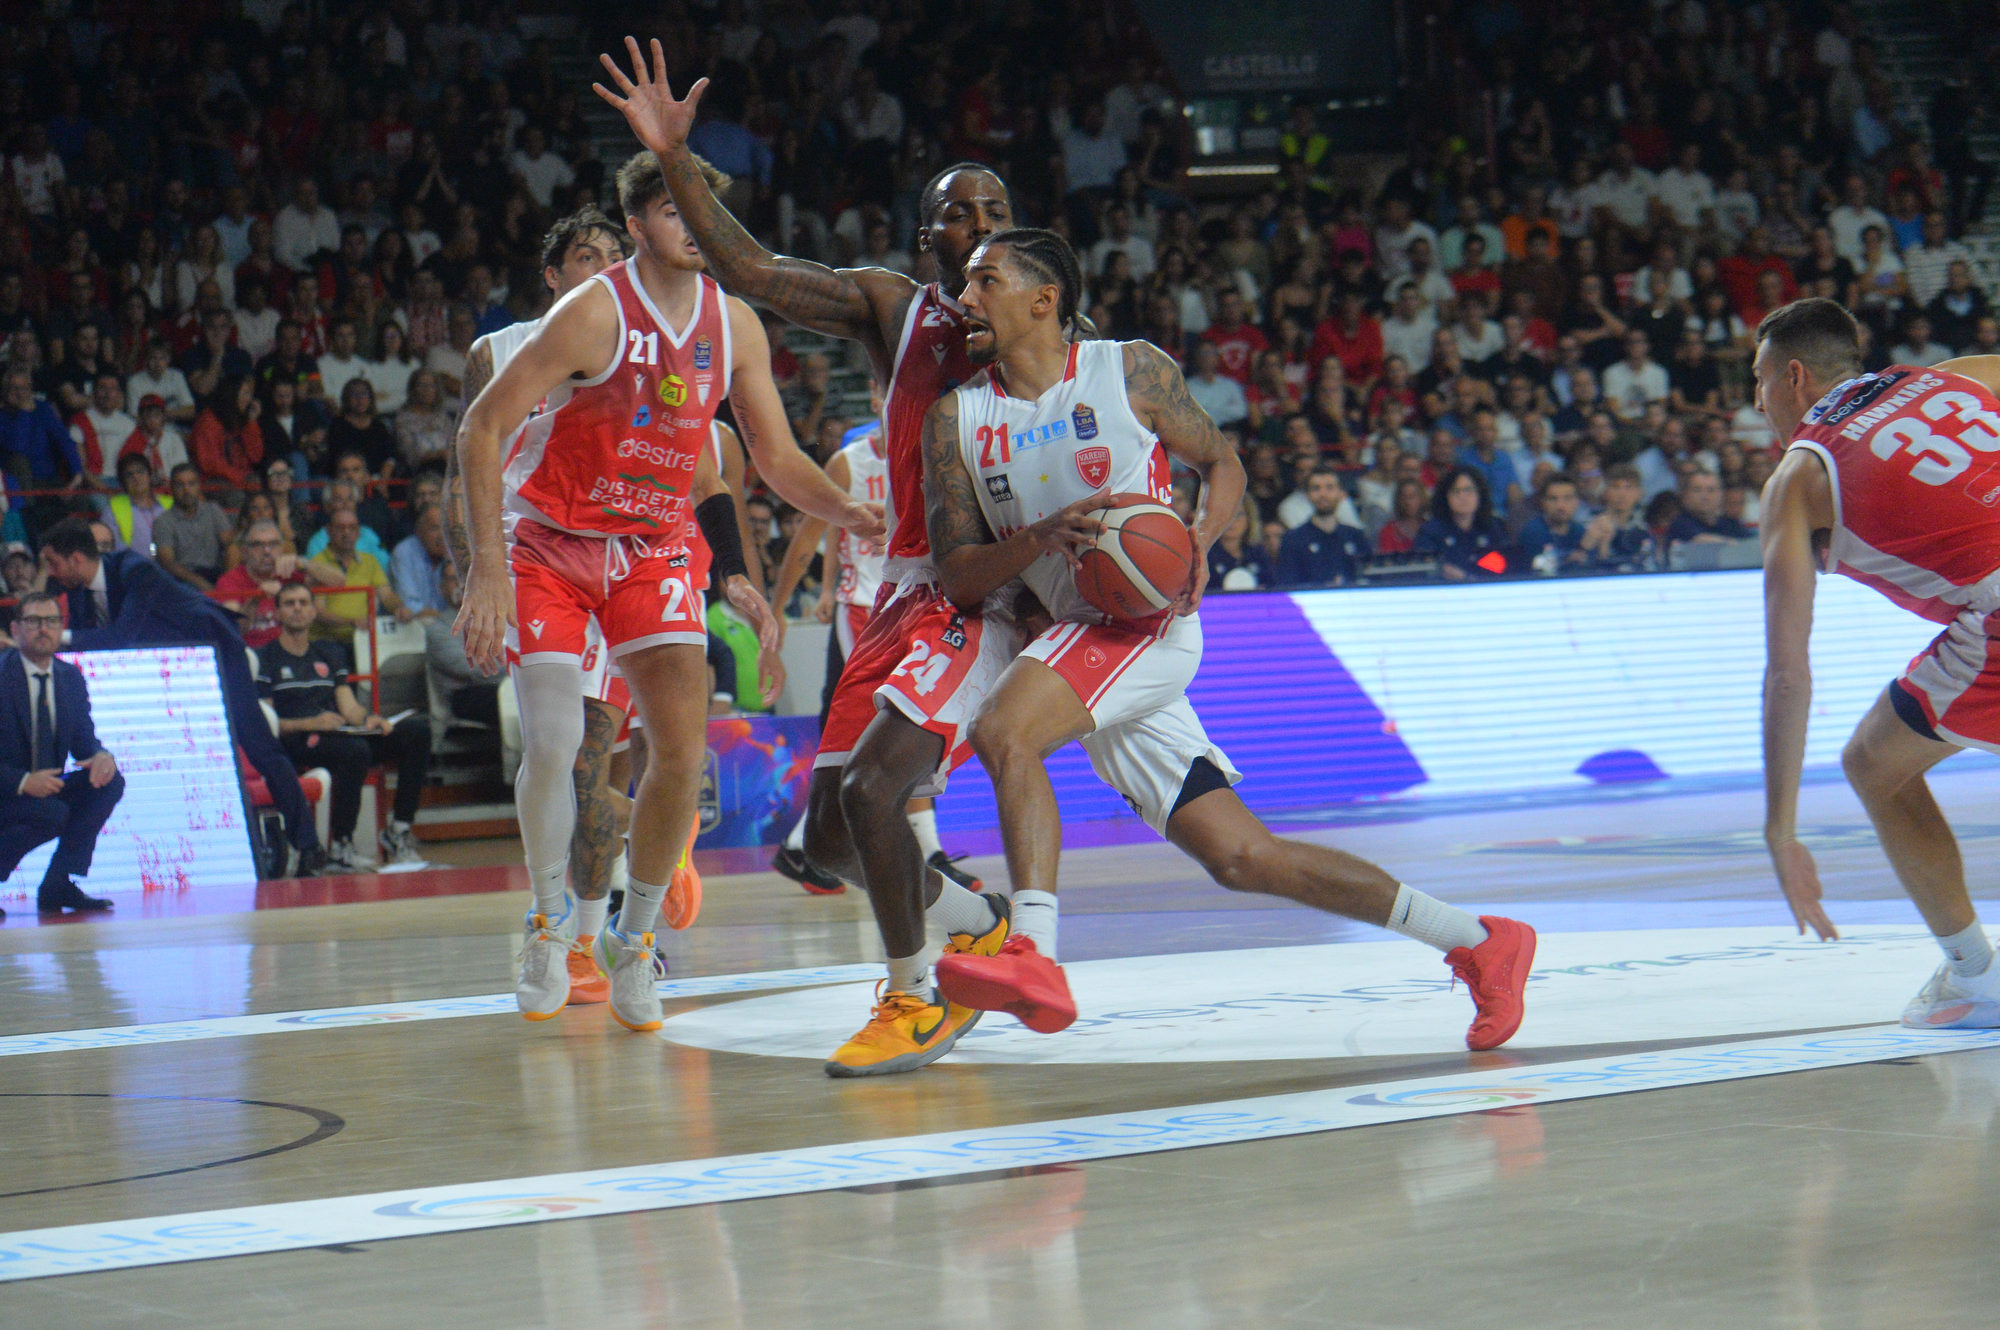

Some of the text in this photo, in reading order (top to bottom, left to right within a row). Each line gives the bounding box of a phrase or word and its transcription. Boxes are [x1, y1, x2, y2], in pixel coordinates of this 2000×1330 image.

[628, 329, 657, 365] 21
[1076, 417, 1093, 426] LBA
[1840, 373, 1944, 441] HAWKINS
[976, 422, 1010, 468] 21
[1079, 451, 1107, 461] VARESE
[1870, 390, 2000, 486] 33
[865, 475, 885, 500] 11
[890, 640, 952, 696] 24
[581, 1112, 1286, 1193] acinque
